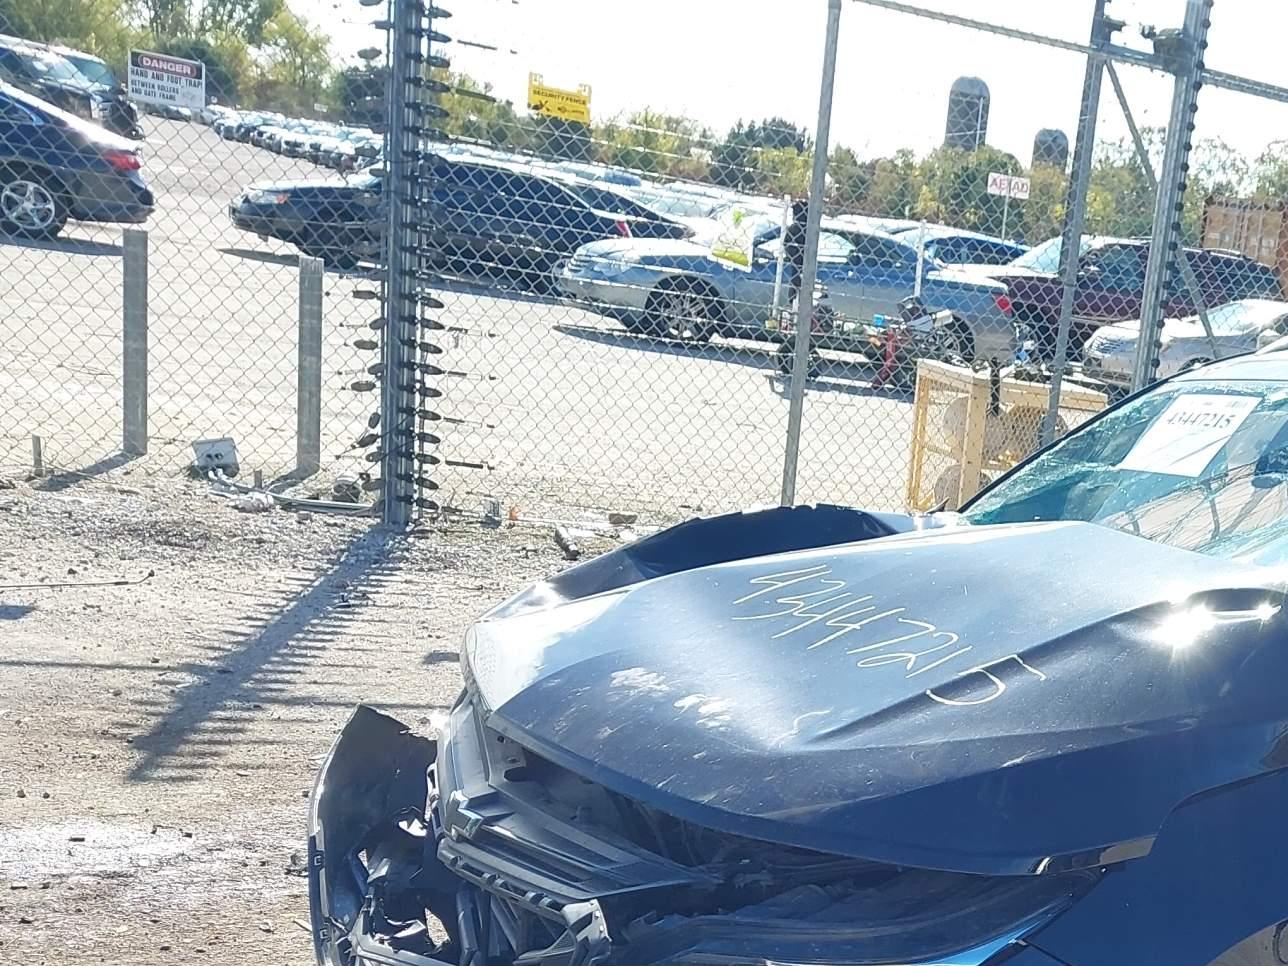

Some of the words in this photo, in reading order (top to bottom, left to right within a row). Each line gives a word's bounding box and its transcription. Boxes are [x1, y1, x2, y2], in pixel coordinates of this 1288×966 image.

[142, 57, 192, 75] DANGER
[130, 67, 149, 79] HAND
[151, 71, 165, 81] AND
[166, 75, 182, 85] FOOT
[130, 80, 156, 90] BETWEEN
[131, 87, 142, 95] AND
[143, 90, 157, 98] GATE
[159, 93, 177, 101] FRAME
[1167, 411, 1237, 429] 43447215
[732, 564, 1047, 706] 43447215
